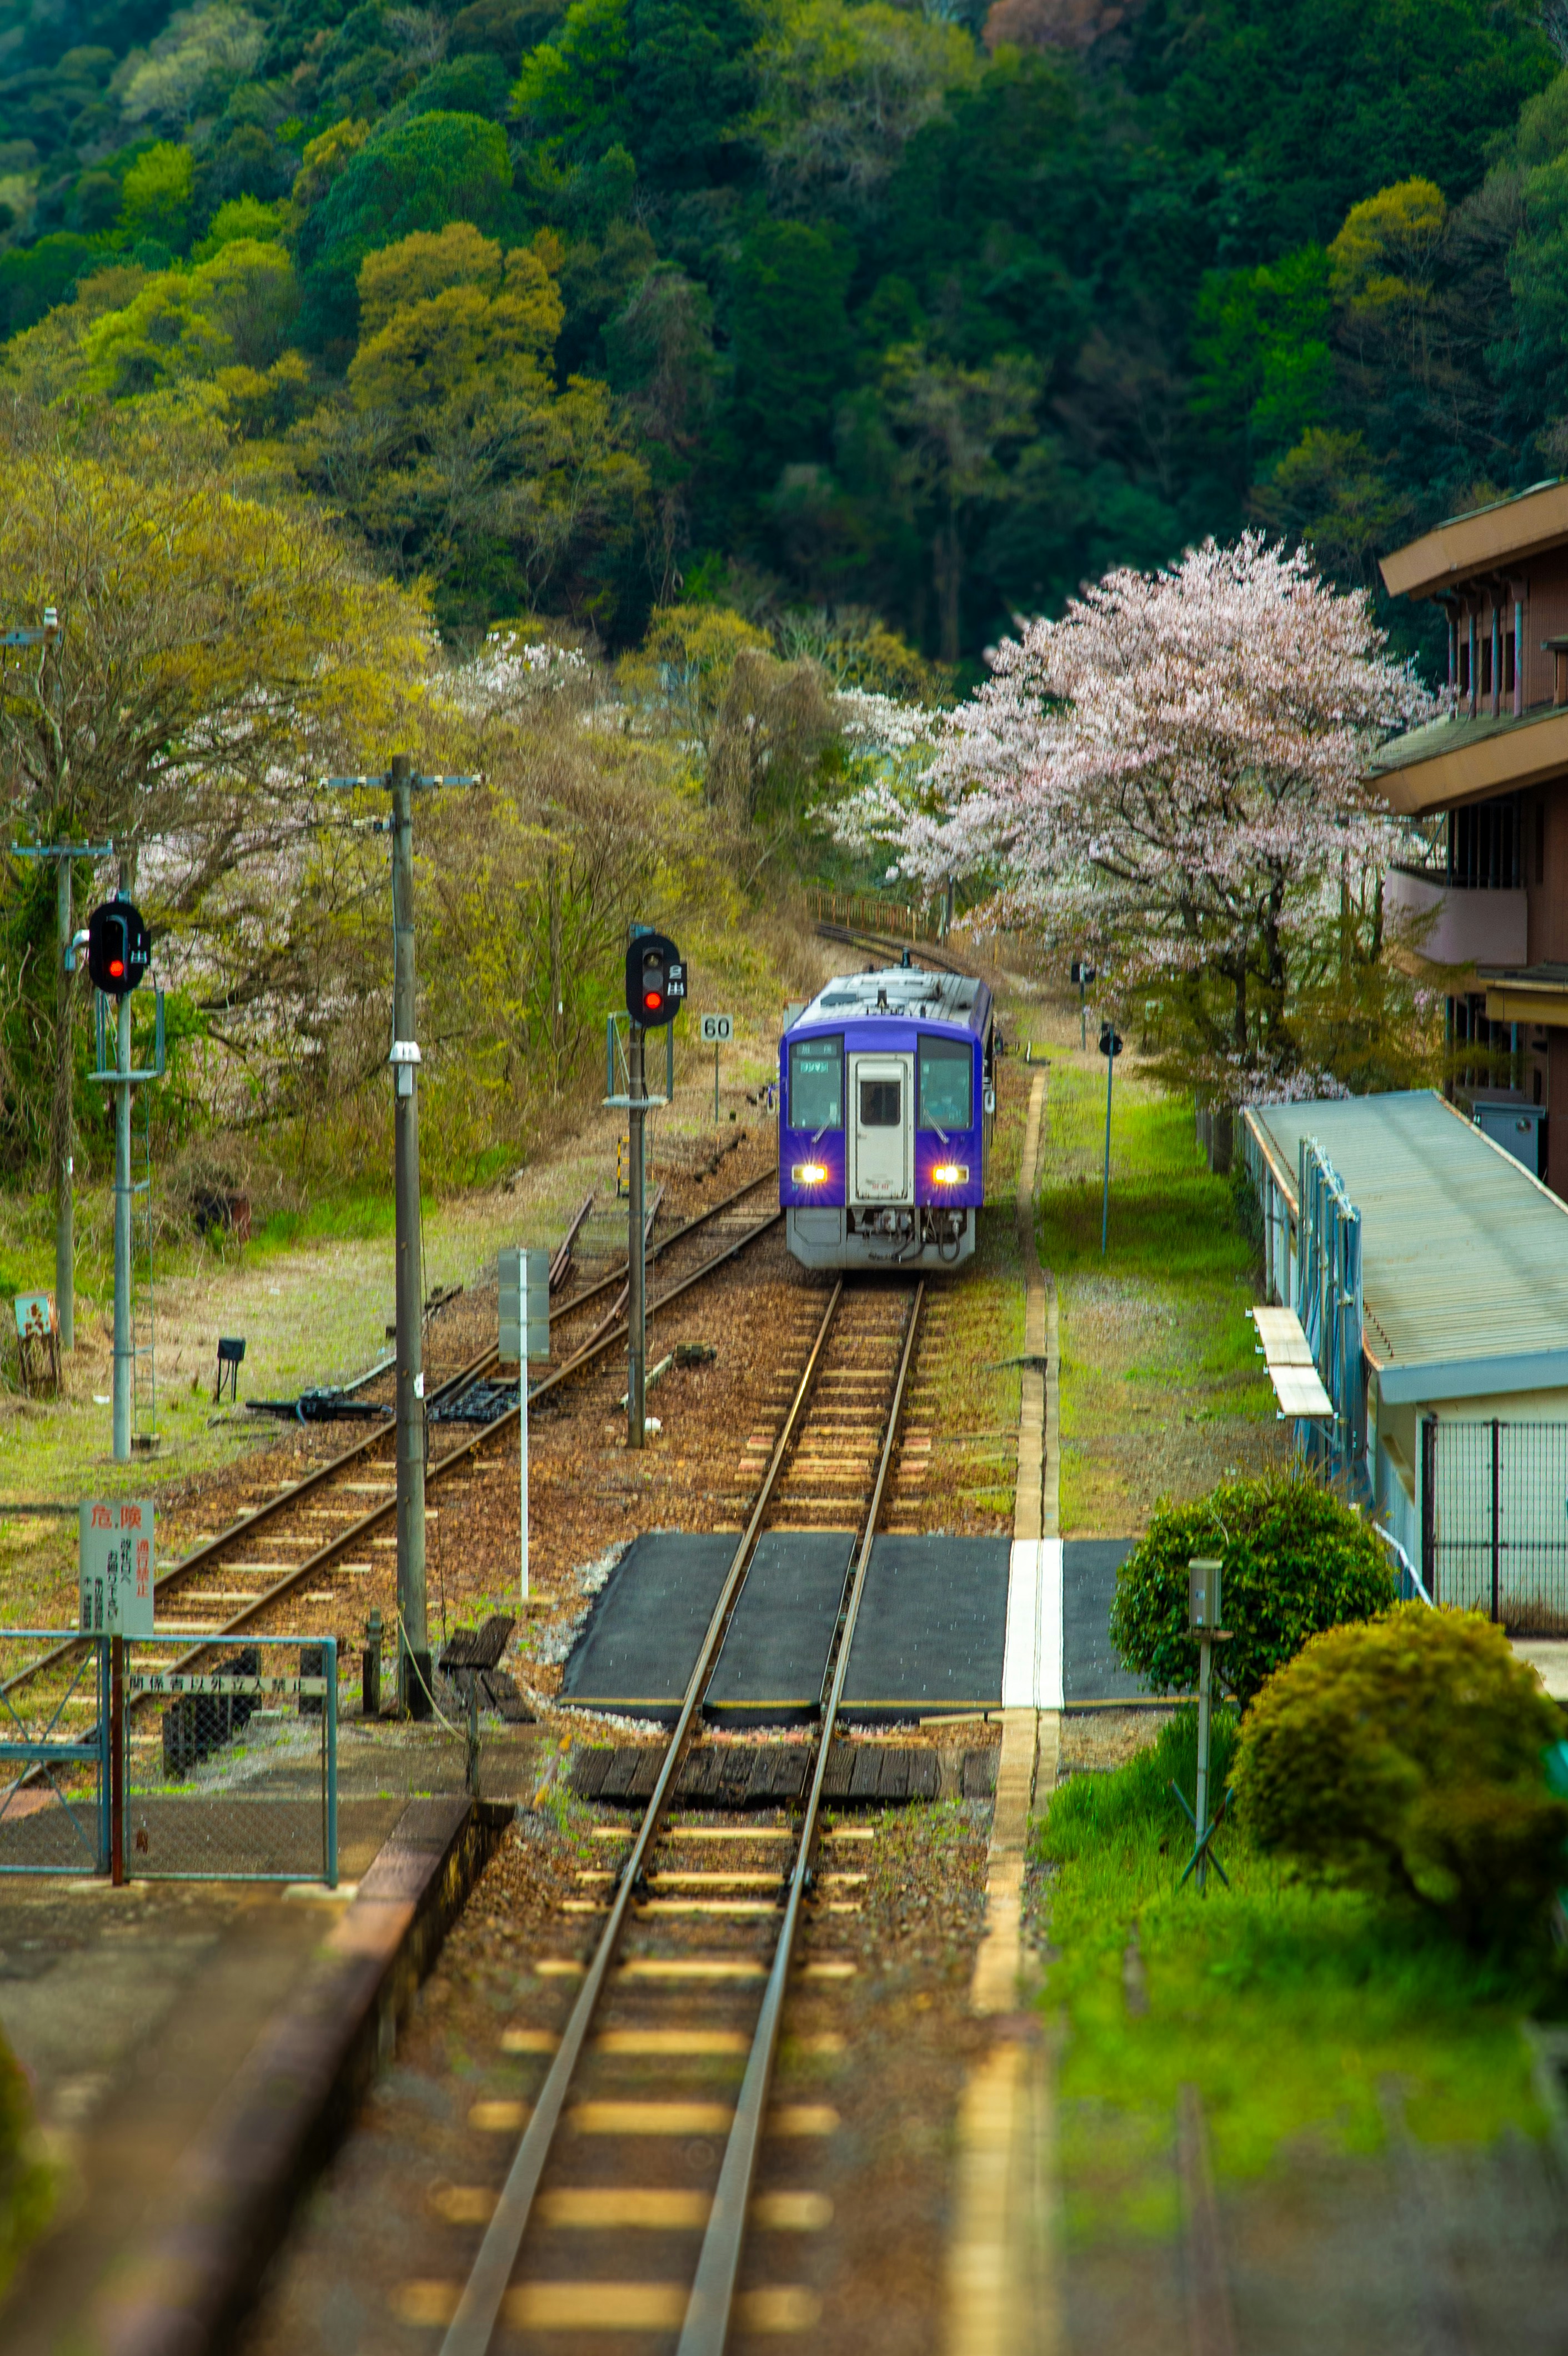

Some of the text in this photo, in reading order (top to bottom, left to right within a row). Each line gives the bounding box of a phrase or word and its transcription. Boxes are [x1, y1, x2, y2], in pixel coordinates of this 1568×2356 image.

[704, 1017, 730, 1039] 60
[91, 1504, 142, 1530] 危険
[136, 1538, 149, 1598] 通行禁止
[129, 1675, 305, 1693] 関係者以外立入禁止
